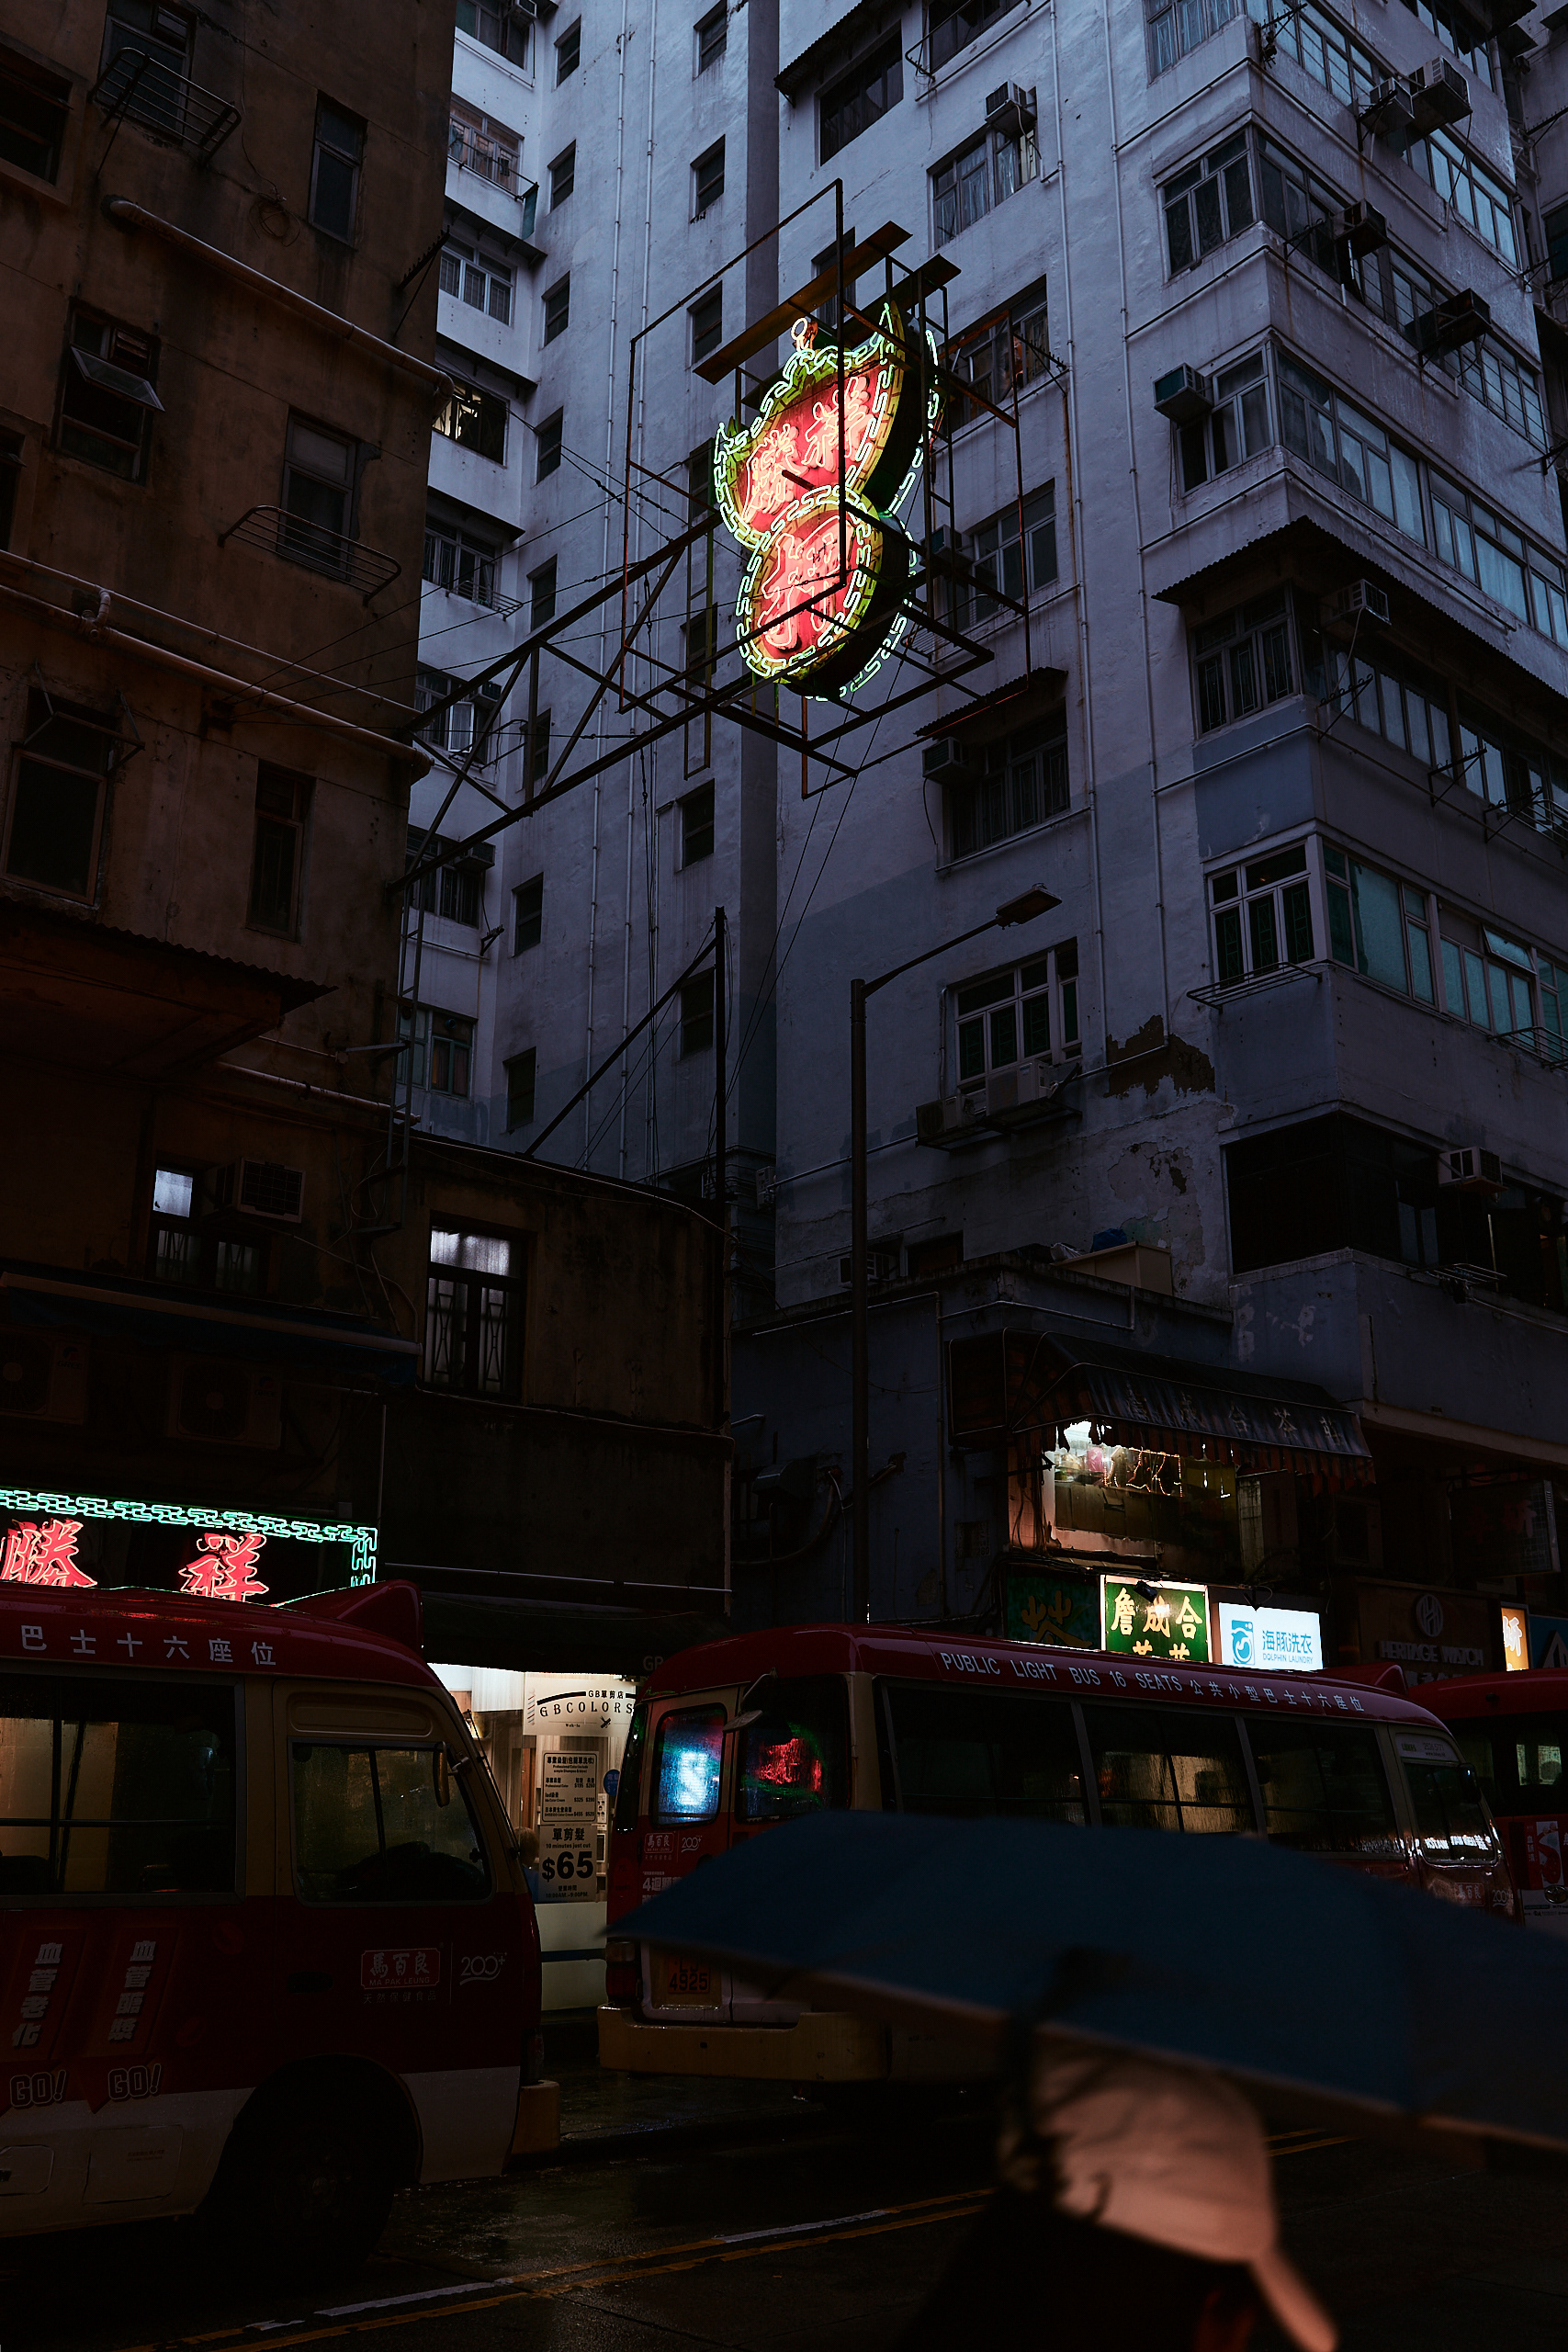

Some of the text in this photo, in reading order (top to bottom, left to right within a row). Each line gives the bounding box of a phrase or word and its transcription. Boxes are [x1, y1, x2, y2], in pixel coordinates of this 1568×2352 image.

[1111, 1587, 1203, 1639] 詹成合
[20, 1624, 276, 1666] 巴士十六座位
[1262, 1630, 1313, 1654] 海豚洗衣
[1381, 1640, 1484, 1667] HERITAGE WATCH
[940, 1652, 1183, 1692] PUBLIC LIGHT BUS 16 SEATS
[1262, 1653, 1314, 1665] DOLPHIN LAUNDRY
[1190, 1679, 1365, 1712] 公共小型巴士十六座位
[552, 1827, 585, 1841] 單剪髮
[647, 1834, 671, 1849] 馬百良
[541, 1850, 593, 1883] $65
[369, 1951, 430, 1979] 馬百良
[404, 1976, 430, 1984] LEUNG
[670, 1973, 709, 1991] 4925
[12, 1942, 63, 2047] 血管老化
[363, 1990, 436, 2005] 天然保健食品
[10, 2069, 68, 2108] GO!
[108, 2064, 162, 2101] GO!
